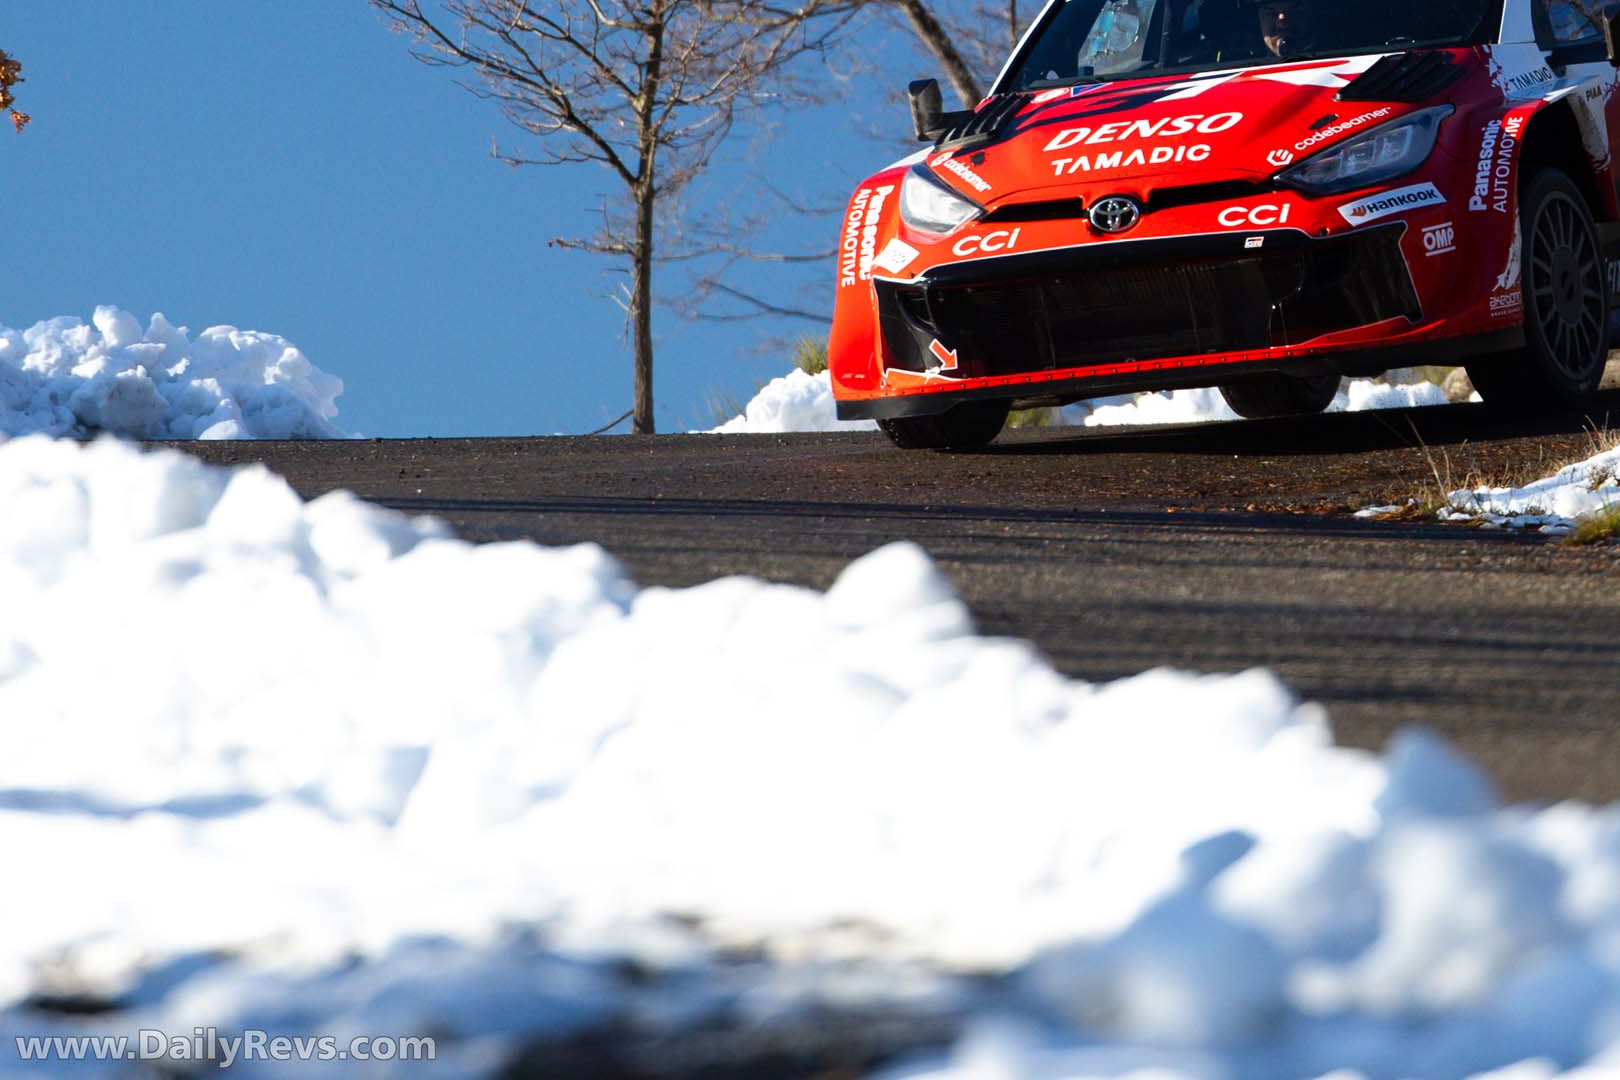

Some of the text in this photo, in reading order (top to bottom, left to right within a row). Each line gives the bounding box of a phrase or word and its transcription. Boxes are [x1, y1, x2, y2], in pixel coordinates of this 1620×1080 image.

[1509, 66, 1553, 90] TAMADIC
[1043, 111, 1244, 152] DENSO
[1294, 107, 1389, 151] codebeamer
[1051, 143, 1212, 177] TAMADIC
[1468, 119, 1502, 211] Panasonic
[1493, 117, 1524, 213] AUTOMOTIVE
[841, 188, 873, 288] AUTOMOTIVE
[859, 185, 895, 281] Panasonic
[1423, 226, 1456, 251] OMP
